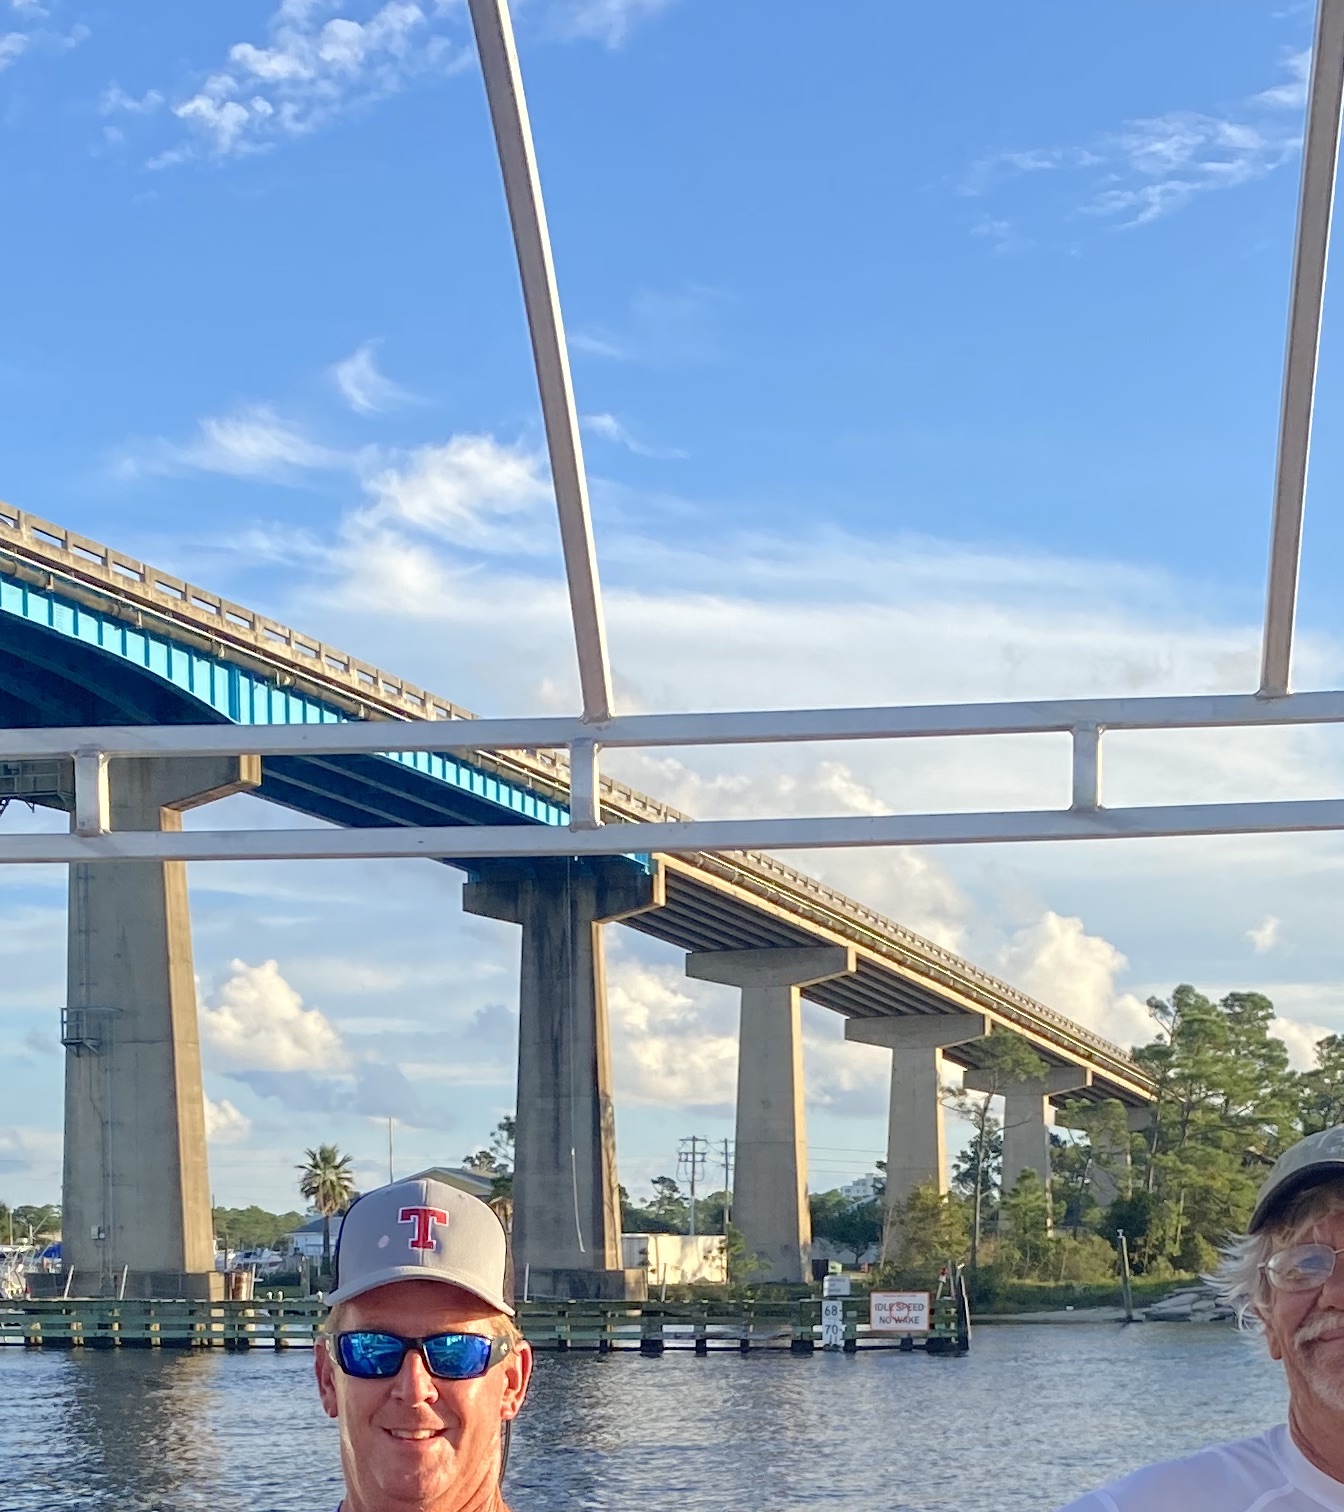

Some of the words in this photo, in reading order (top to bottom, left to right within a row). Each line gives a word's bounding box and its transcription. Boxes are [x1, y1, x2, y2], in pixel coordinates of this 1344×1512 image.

[398, 1206, 449, 1250] T
[824, 1305, 838, 1316] 68
[875, 1303, 894, 1311] IDLE
[896, 1303, 925, 1311] SPEED
[879, 1316, 892, 1324] NO
[895, 1316, 920, 1324] WAKE
[825, 1324, 838, 1335] 70
